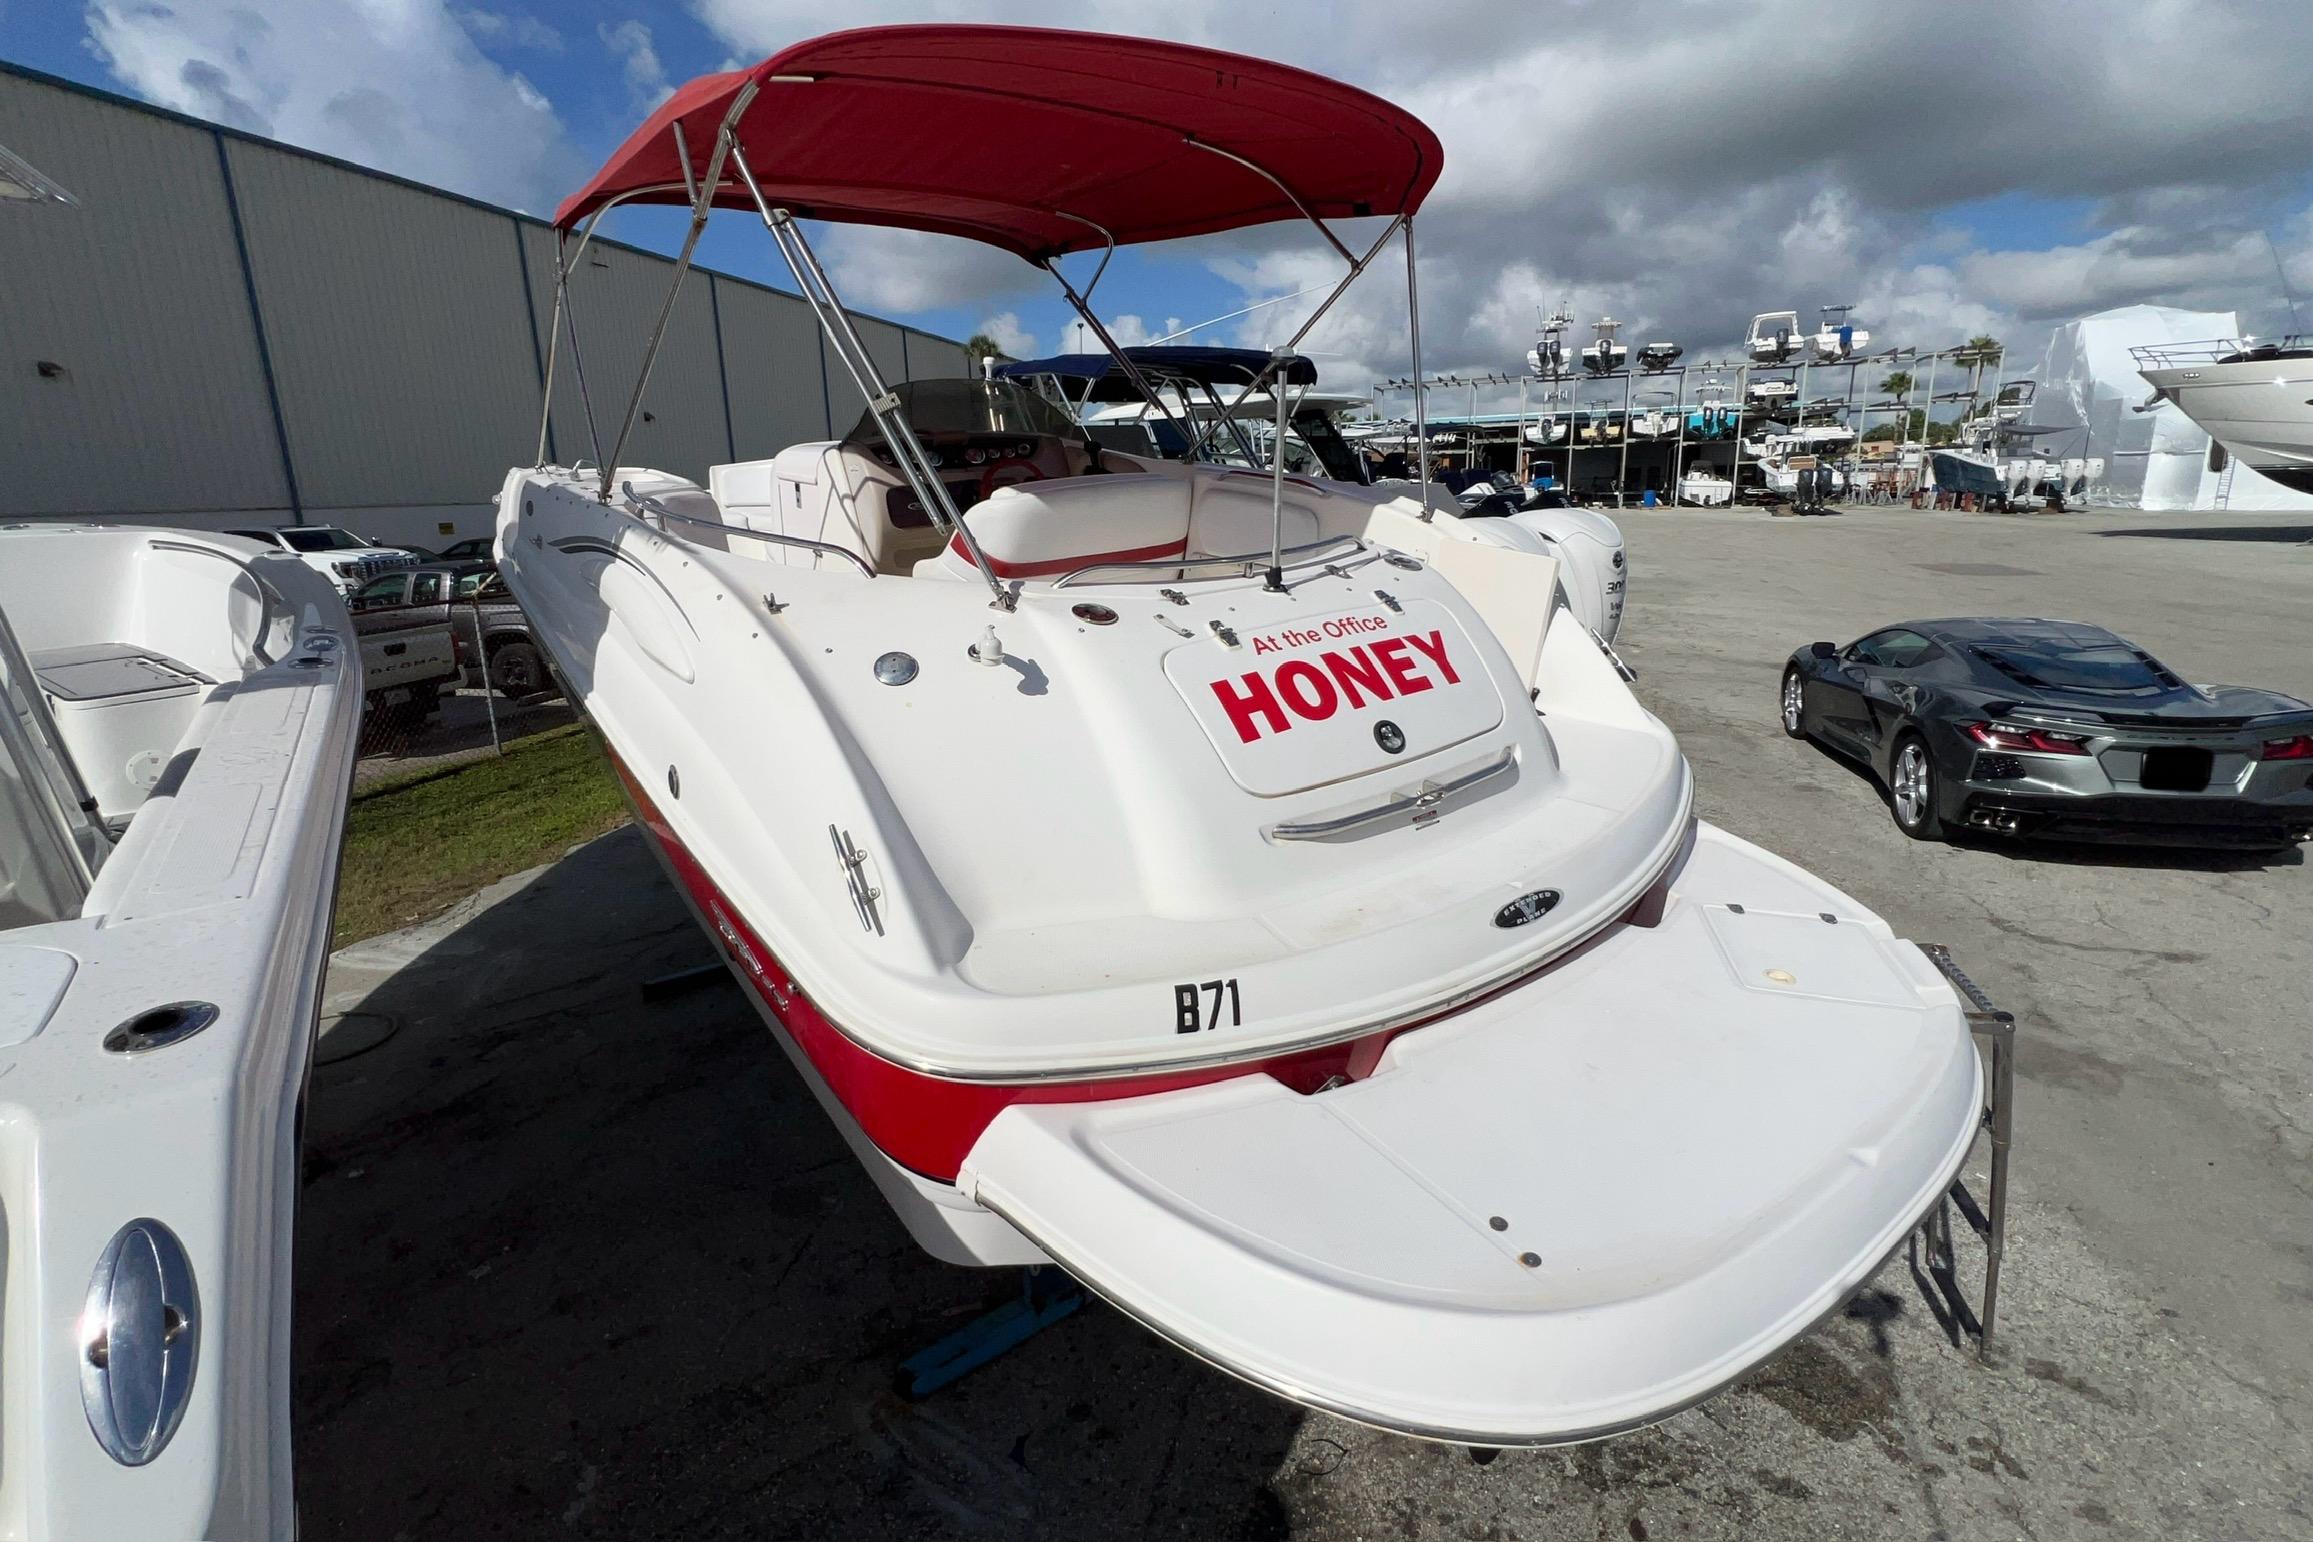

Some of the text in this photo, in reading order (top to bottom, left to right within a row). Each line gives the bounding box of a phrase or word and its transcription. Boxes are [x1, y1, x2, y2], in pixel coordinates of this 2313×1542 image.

[1252, 616, 1388, 655] At the Office
[370, 656, 438, 675] ACOMA
[1210, 630, 1461, 744] HONEY
[1503, 891, 1551, 916] EXTENDED
[1516, 907, 1546, 924] PLANE
[1174, 978, 1241, 1034] B71
